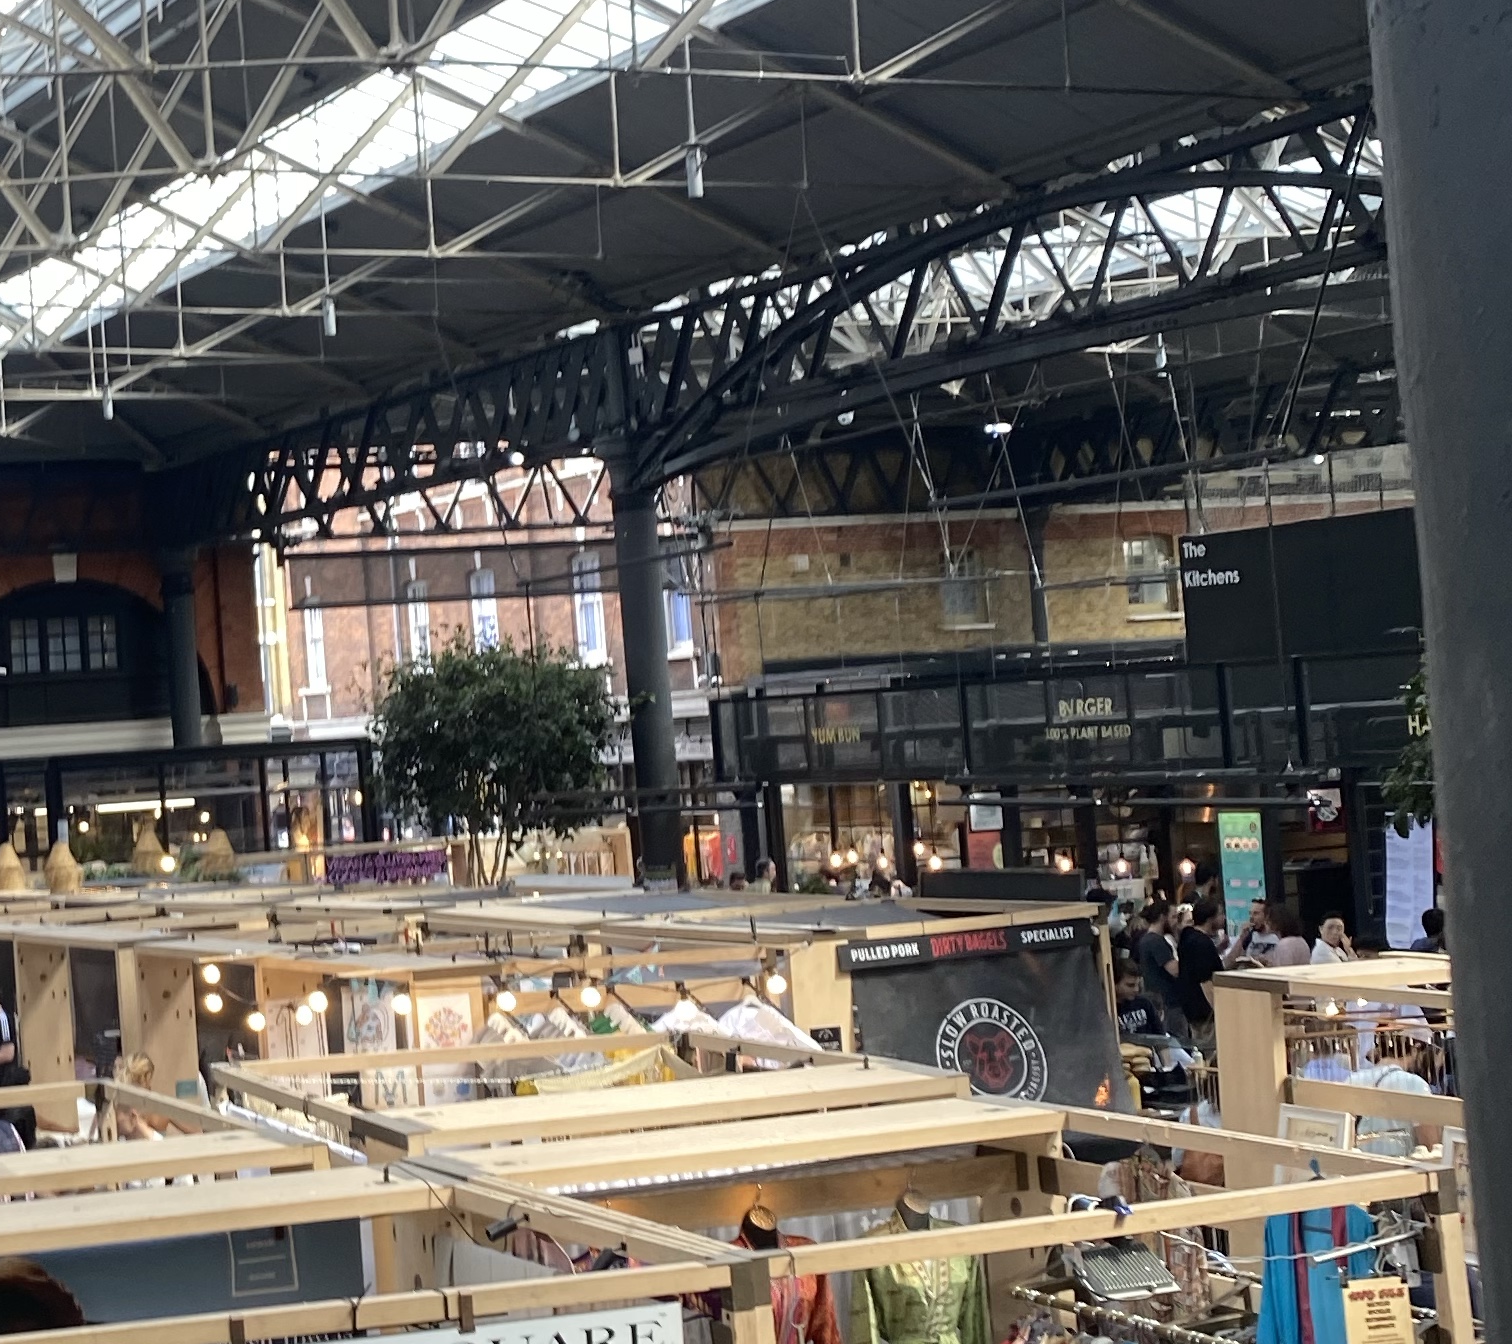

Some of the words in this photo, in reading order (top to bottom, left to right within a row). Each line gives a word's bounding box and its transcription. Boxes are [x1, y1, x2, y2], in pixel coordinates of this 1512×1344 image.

[1183, 541, 1207, 559] The
[1184, 568, 1241, 588] Kitchens
[811, 727, 837, 745] YUM
[838, 726, 861, 744] BUN
[1070, 725, 1099, 741] PLANT
[1101, 723, 1132, 739] BASED
[851, 946, 889, 962] PULLED
[891, 942, 920, 958] PORK
[930, 933, 963, 958] DIRTY
[1020, 926, 1076, 944] SPECIALIST
[940, 1010, 969, 1060] SLOW
[969, 1002, 1036, 1052] ROASTED
